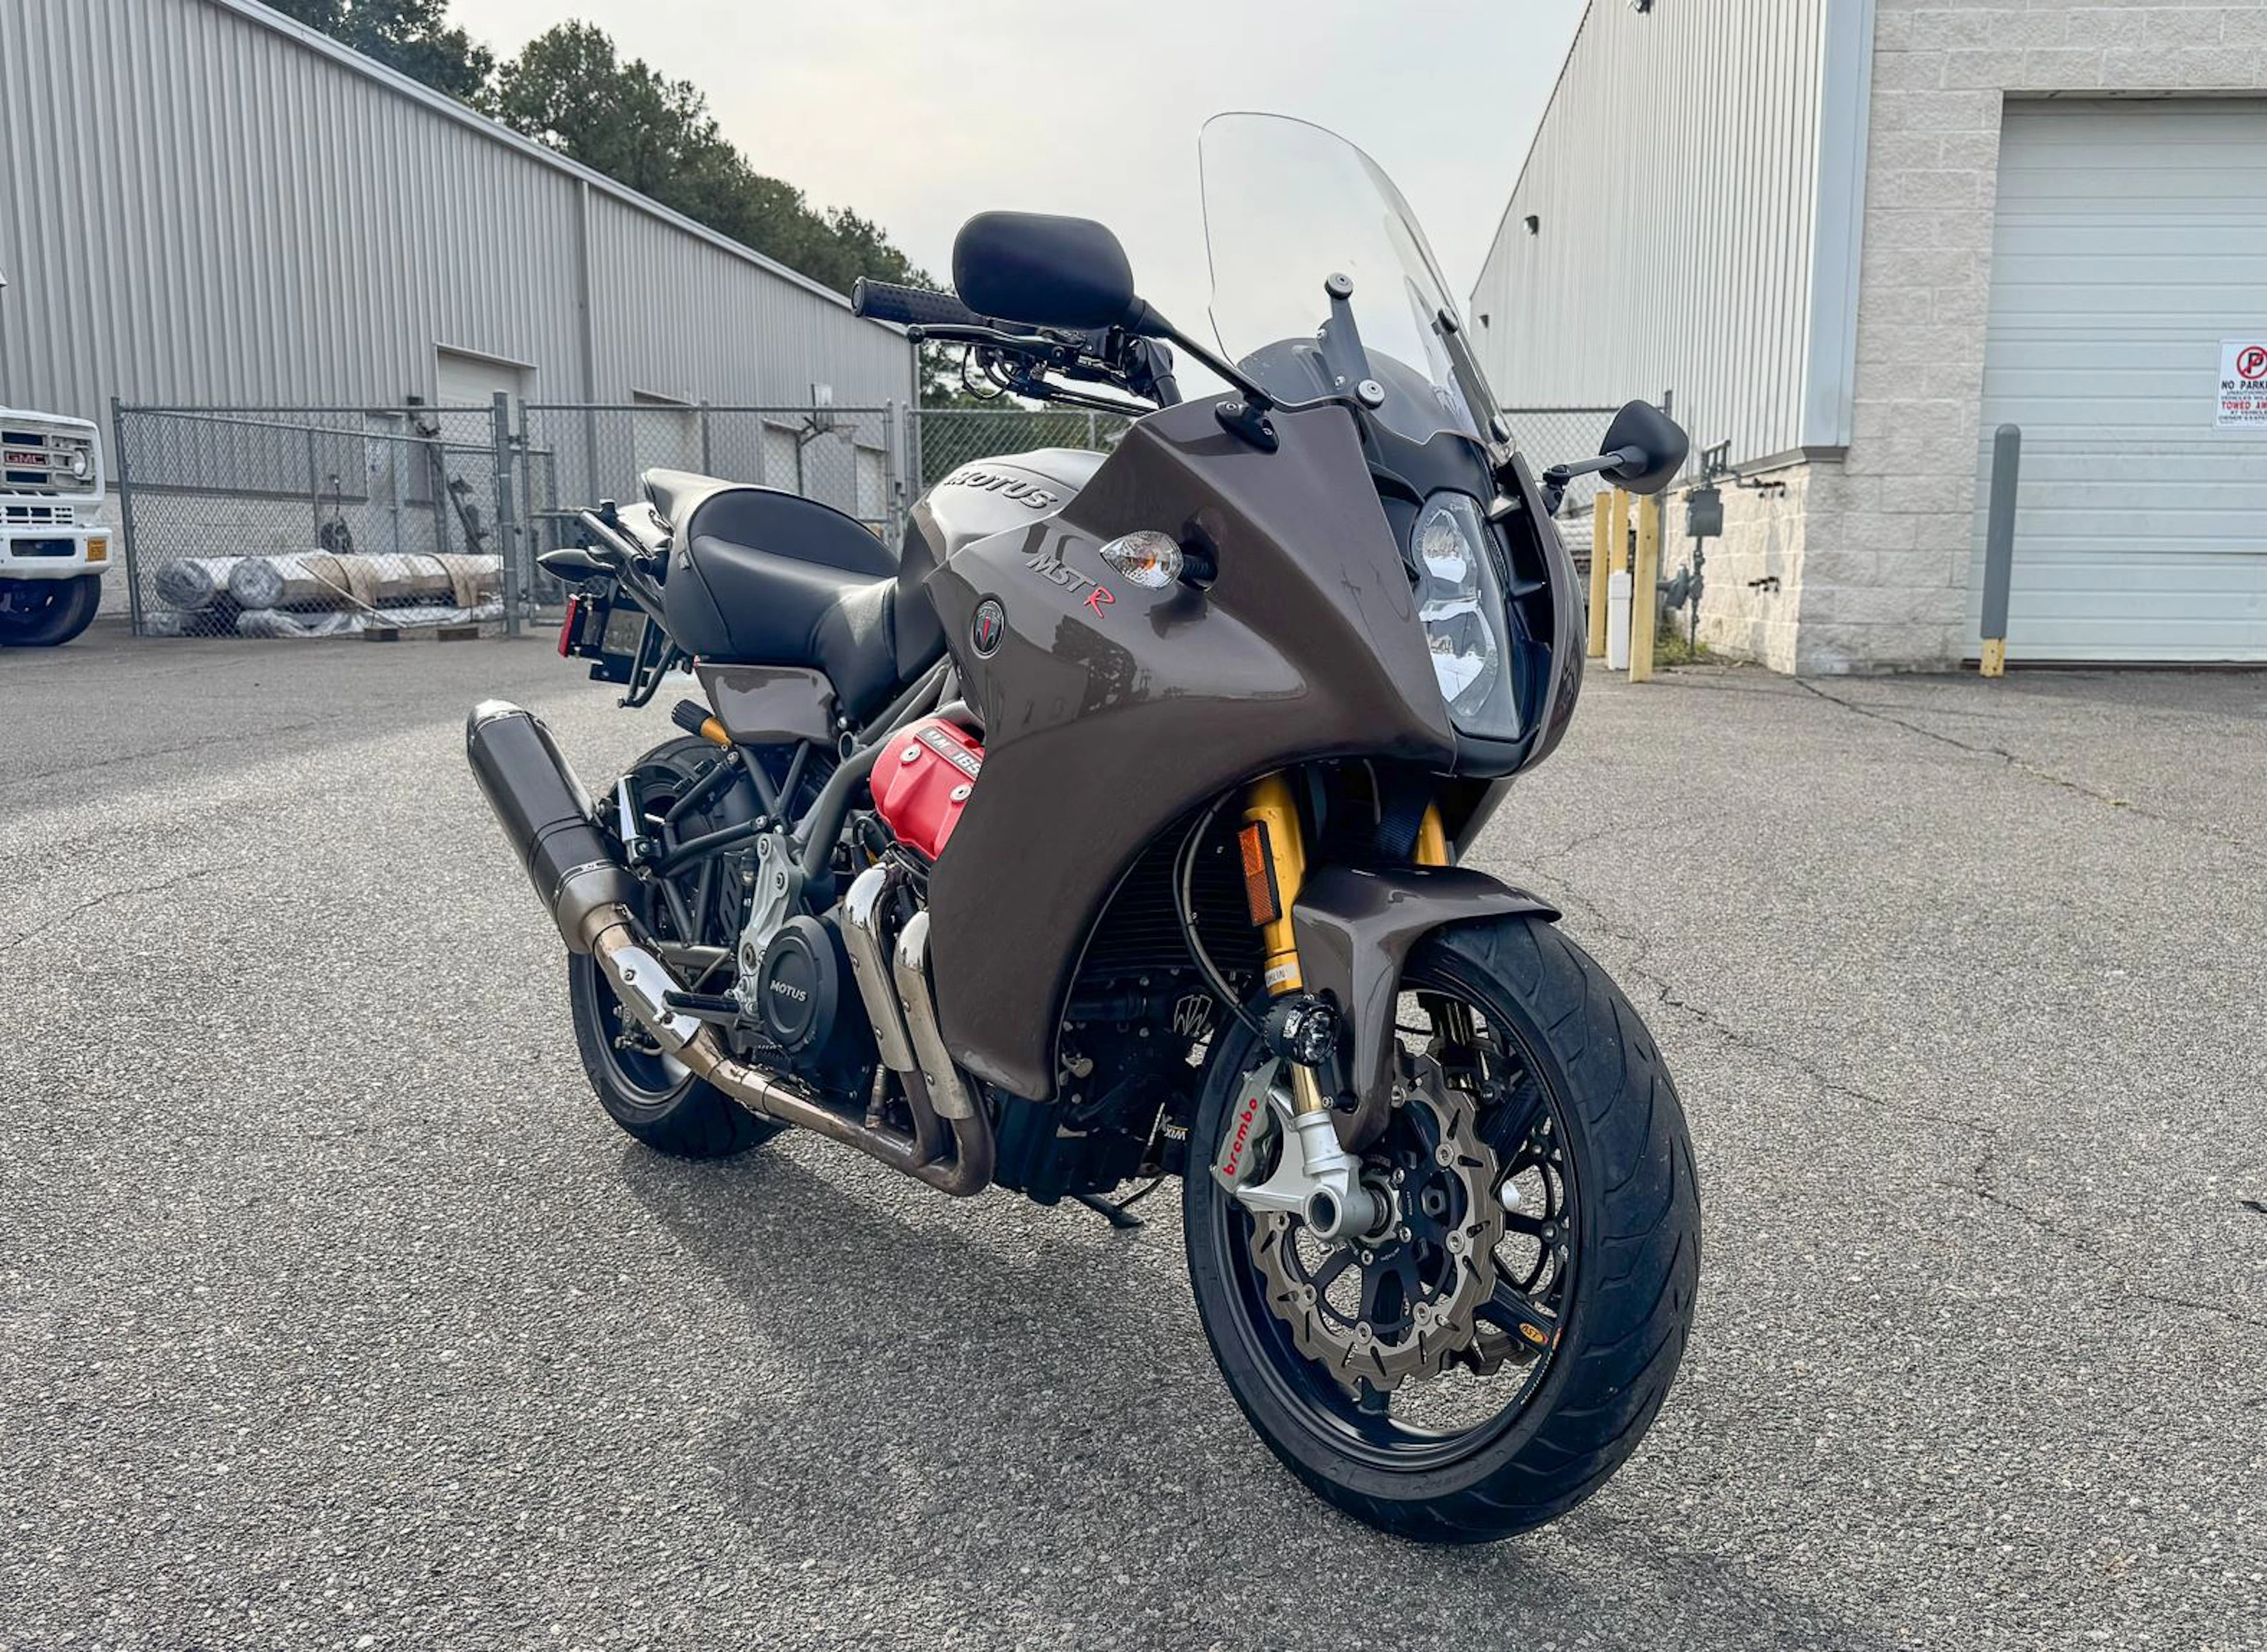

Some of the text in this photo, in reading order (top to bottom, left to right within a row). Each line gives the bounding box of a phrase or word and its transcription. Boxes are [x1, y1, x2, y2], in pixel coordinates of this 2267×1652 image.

[2221, 380, 2235, 390] NO
[2222, 401, 2251, 409] TOWED
[5, 452, 45, 465] GMC
[943, 471, 1059, 509] MOTUS
[770, 980, 807, 1002] MOTUS
[1223, 1098, 1258, 1176] brembo
